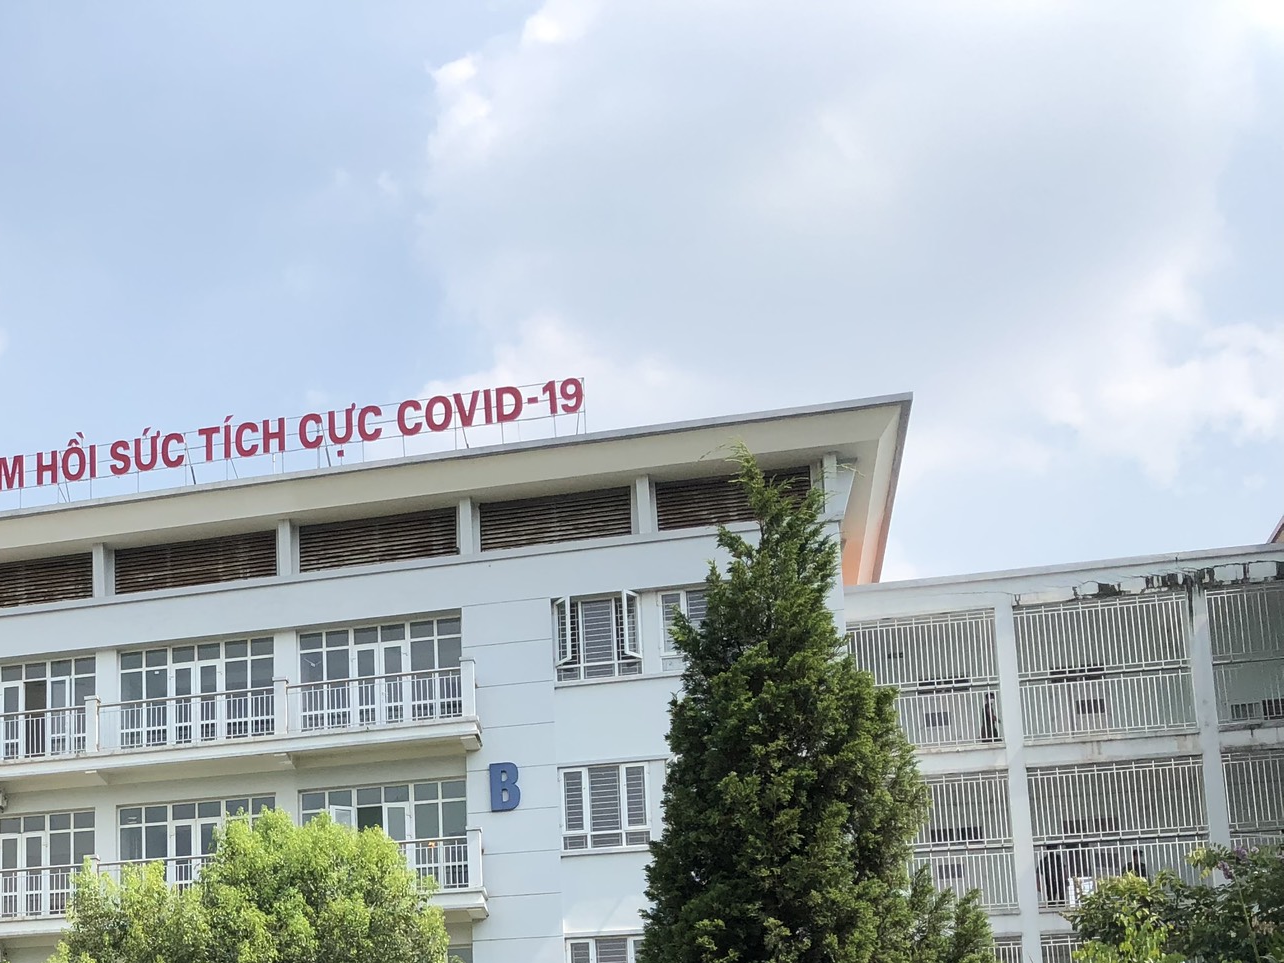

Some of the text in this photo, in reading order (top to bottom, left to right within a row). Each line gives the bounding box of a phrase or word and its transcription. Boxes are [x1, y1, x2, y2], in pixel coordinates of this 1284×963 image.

[36, 431, 98, 487] HỒI
[109, 426, 186, 476] SỨC
[198, 414, 286, 462] TÍCH
[298, 402, 383, 458] CỰC
[397, 377, 584, 436] COVID-19
[489, 762, 521, 813] B
